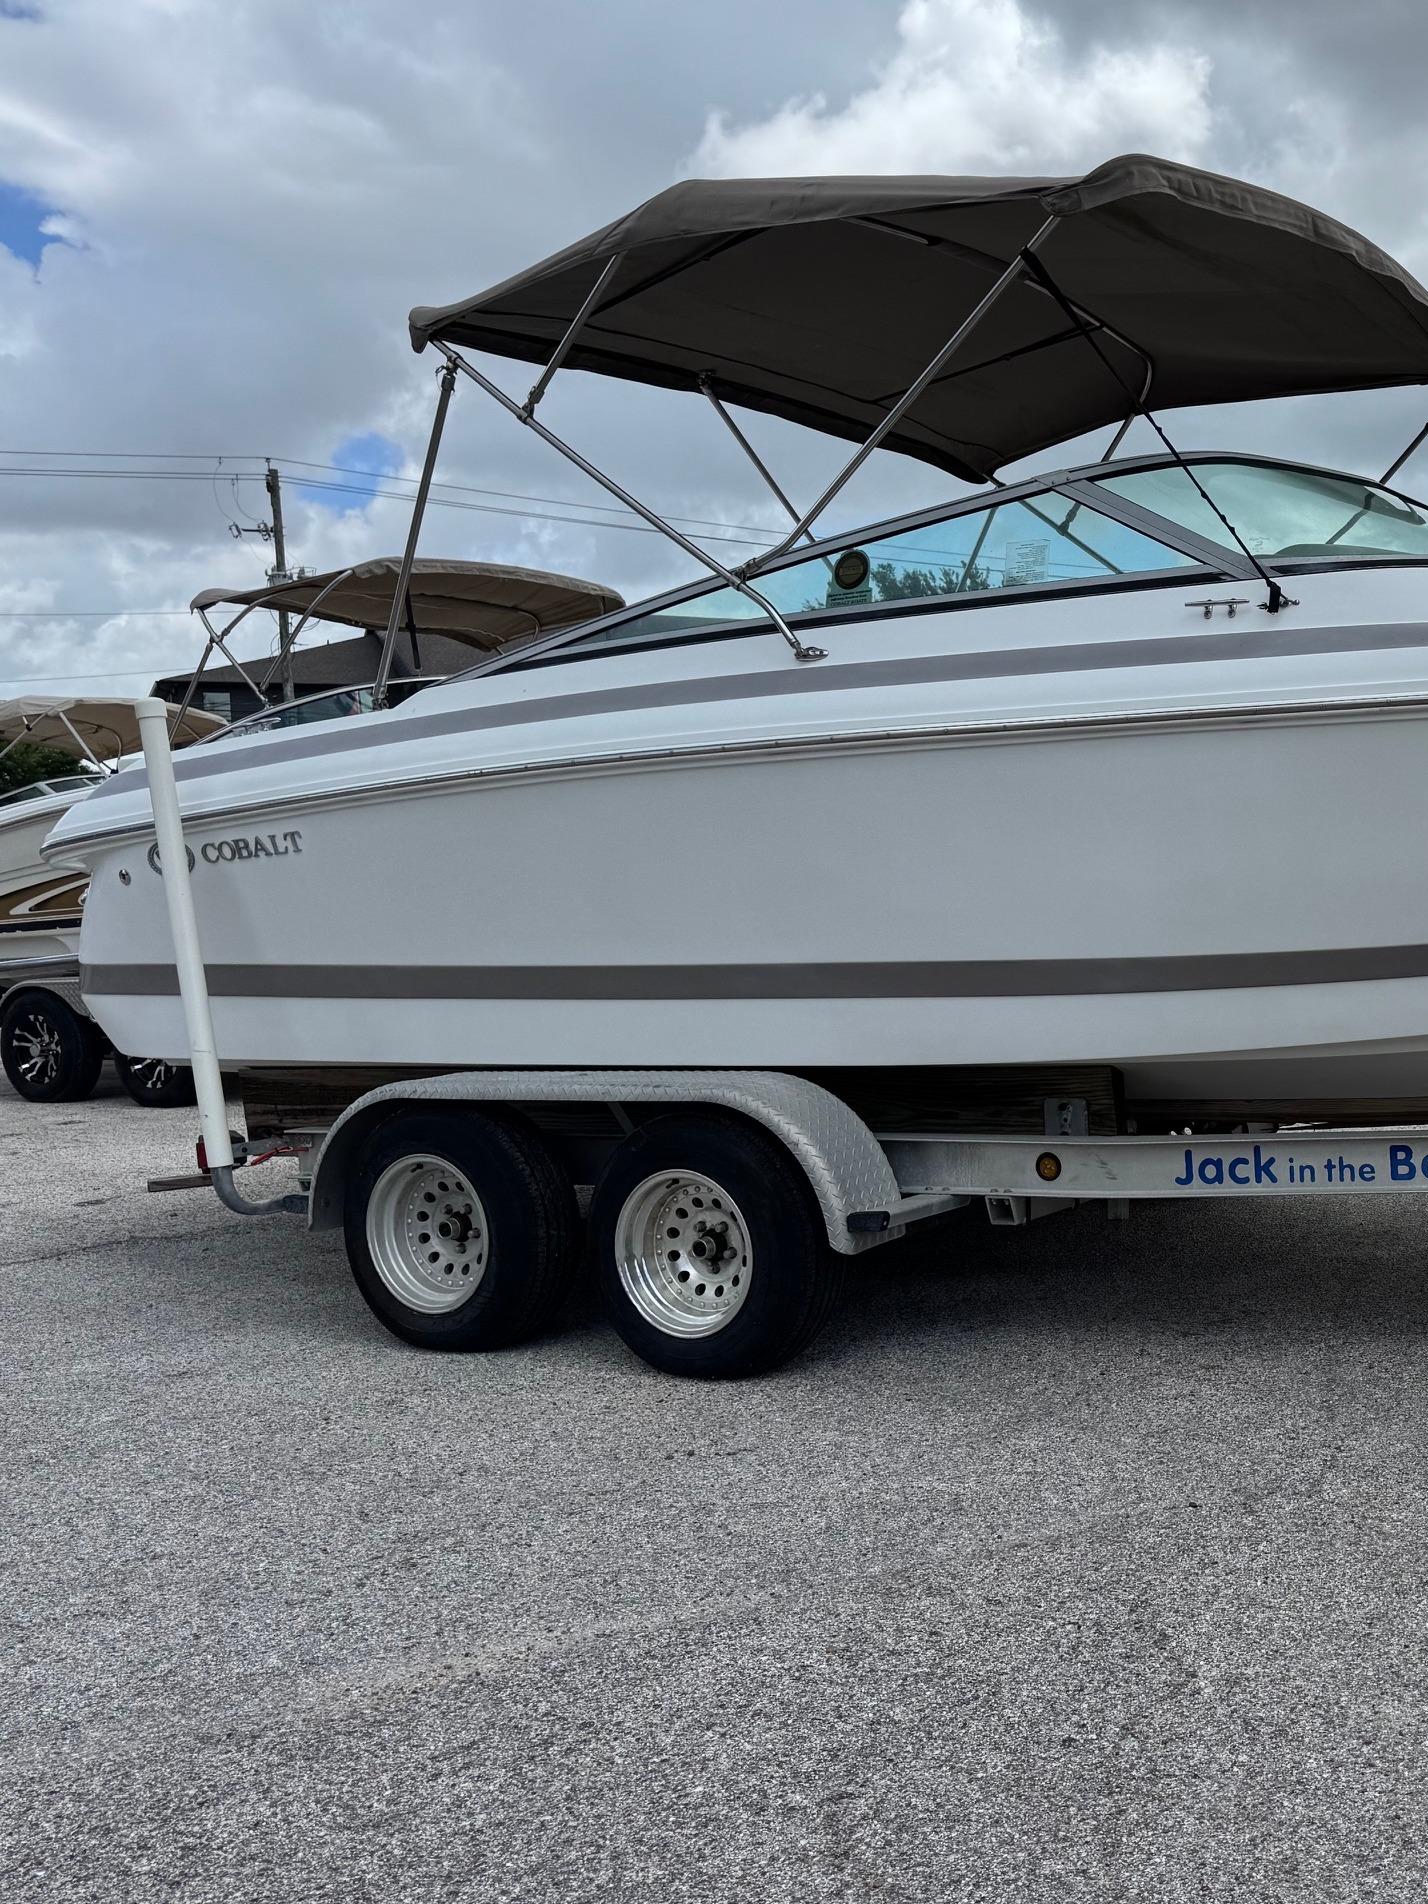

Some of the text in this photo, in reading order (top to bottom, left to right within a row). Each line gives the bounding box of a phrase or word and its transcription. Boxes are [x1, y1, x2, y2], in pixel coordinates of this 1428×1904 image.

[201, 831, 303, 864] COBALT
[1175, 1144, 1279, 1185] Jack
[1288, 1157, 1316, 1183] in
[1323, 1156, 1376, 1183] the
